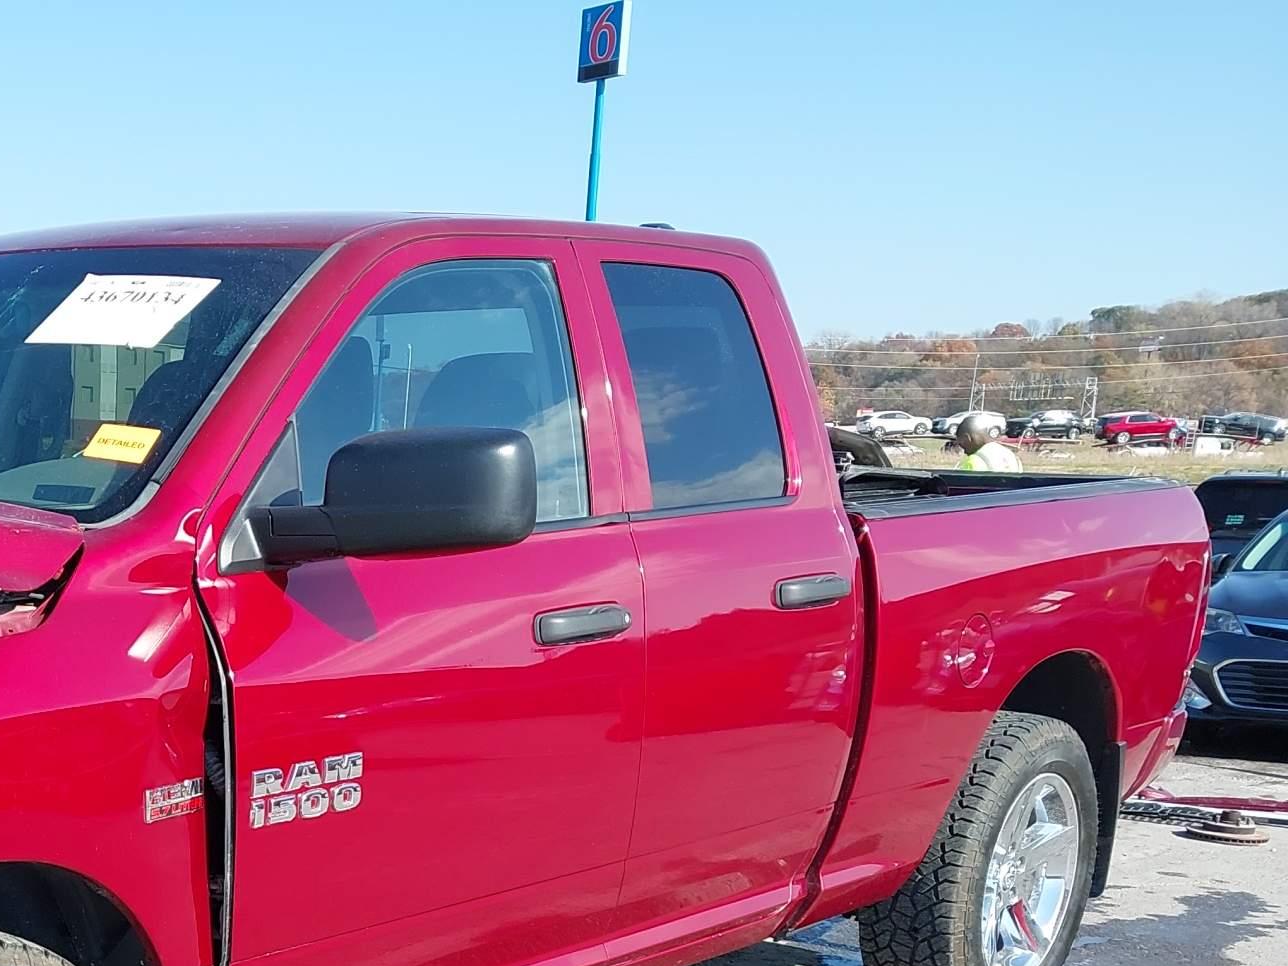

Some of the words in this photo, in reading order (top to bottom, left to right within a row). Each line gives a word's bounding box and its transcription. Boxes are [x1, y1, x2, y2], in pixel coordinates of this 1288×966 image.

[588, 4, 617, 64] 6
[96, 436, 146, 450] DETAILED
[250, 752, 363, 799] RAM
[250, 783, 362, 828] 1500
